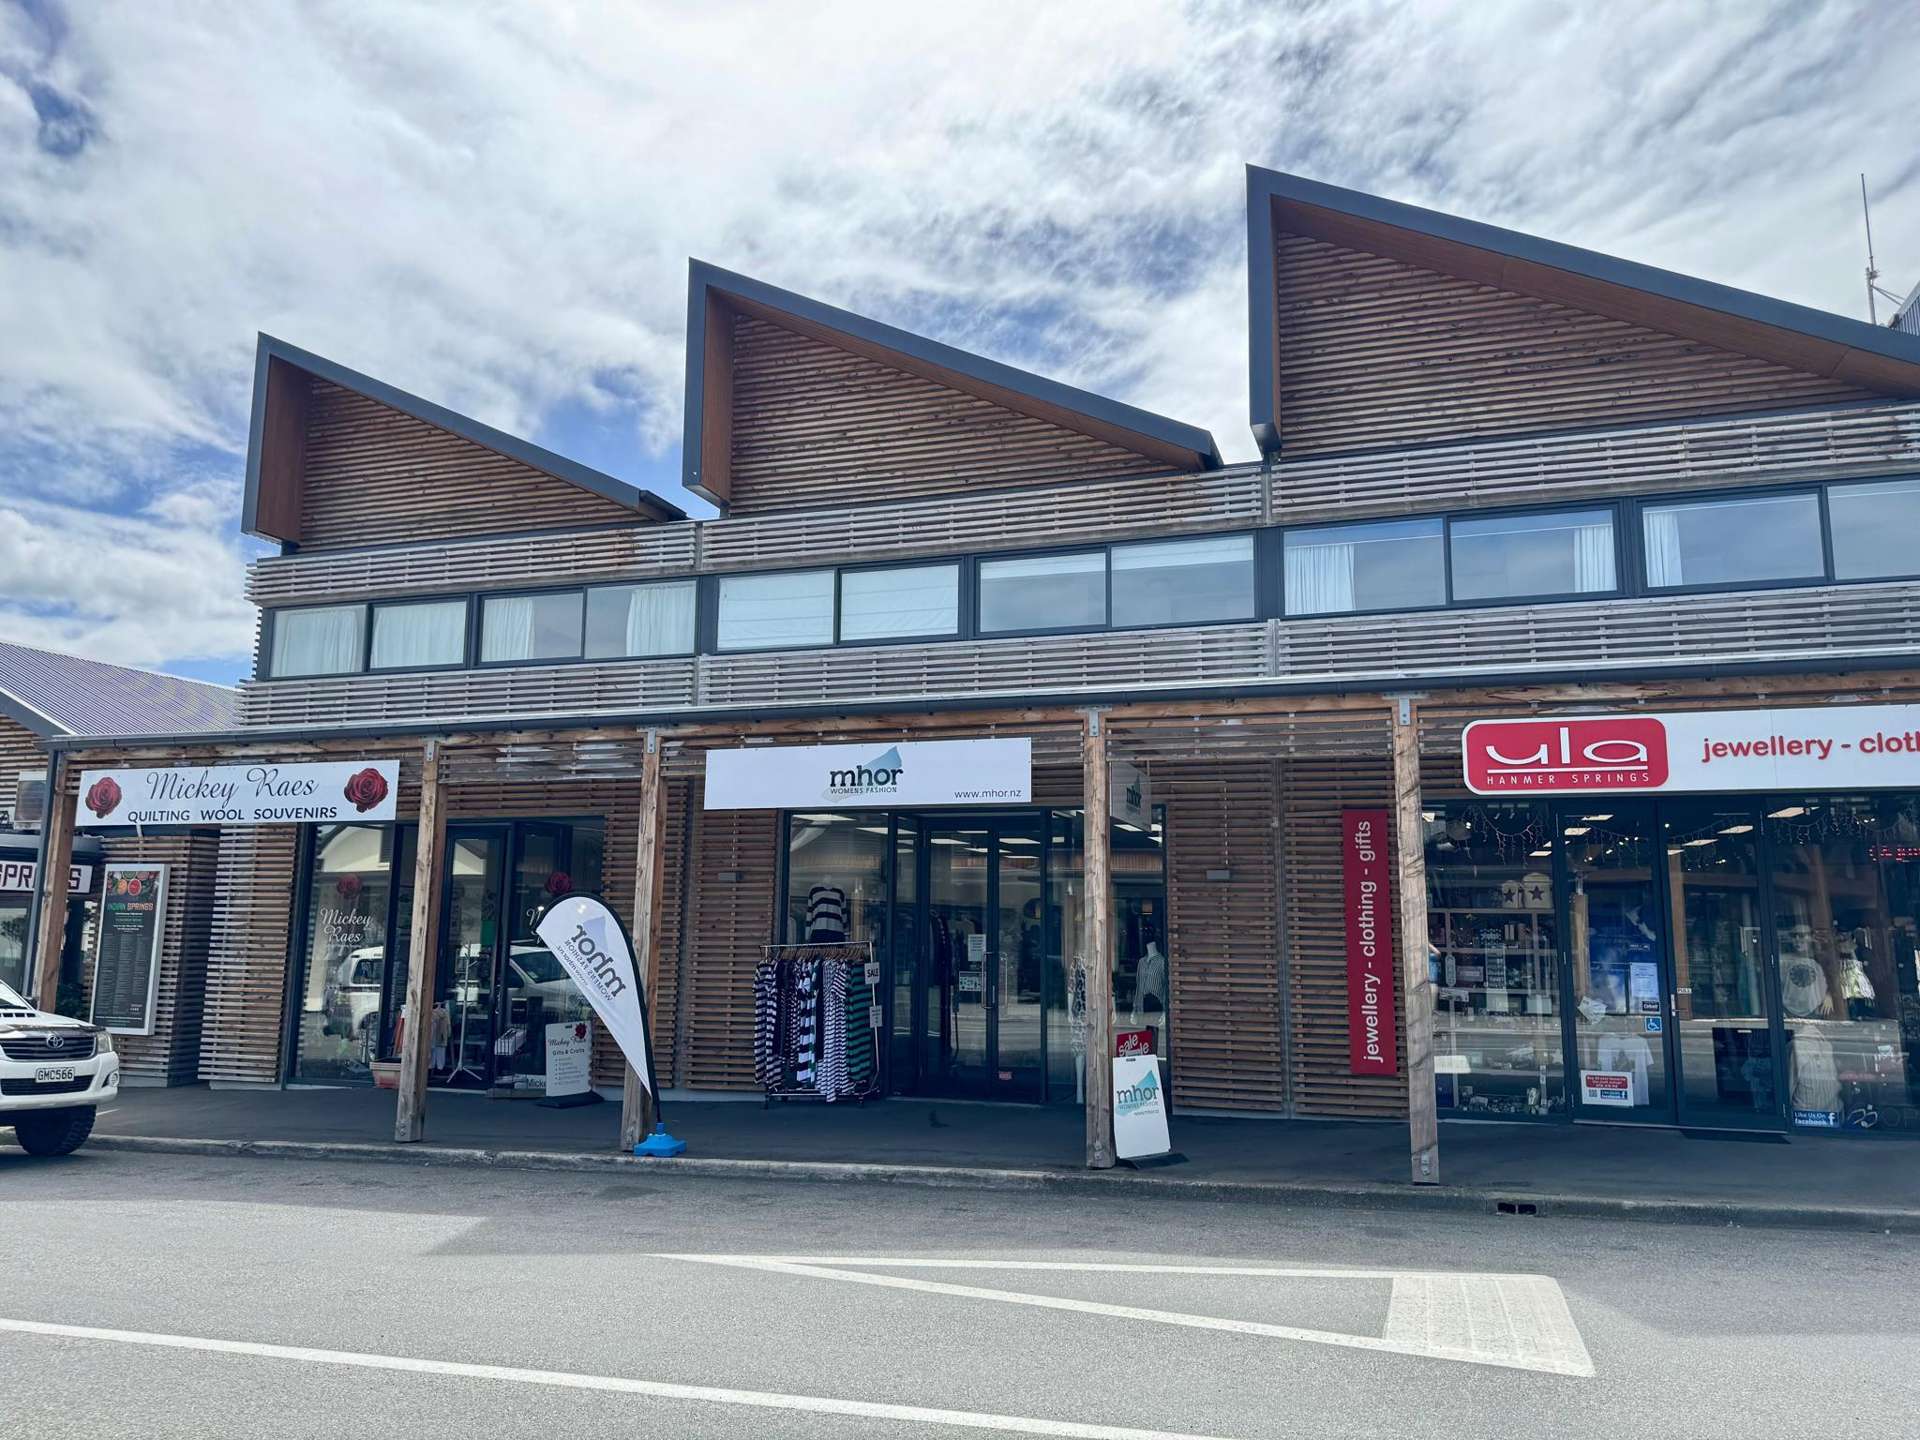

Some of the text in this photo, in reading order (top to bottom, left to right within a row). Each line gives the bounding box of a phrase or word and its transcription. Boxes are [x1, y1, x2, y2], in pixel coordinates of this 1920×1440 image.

[1486, 727, 1648, 765] ula
[1701, 735, 1833, 763] jewellery
[830, 765, 904, 787] mhor
[1487, 772, 1649, 785] HANMER SPRINGS
[146, 767, 319, 808] Mickey Raes
[830, 786, 898, 795] WOMENS FASHION
[954, 789, 1022, 799] www.mhor.nz
[127, 806, 338, 823] QUILTING WOOL SOUVENIRS
[1355, 821, 1376, 862] gifts
[320, 908, 373, 931] Mickey
[1357, 881, 1377, 957] clothing
[323, 925, 363, 943] Raes
[867, 967, 879, 978] SALE
[1361, 972, 1383, 1064] jewellery
[1118, 1034, 1139, 1057] sale
[38, 1069, 73, 1081] GMC566
[1116, 1084, 1159, 1104] mhor
